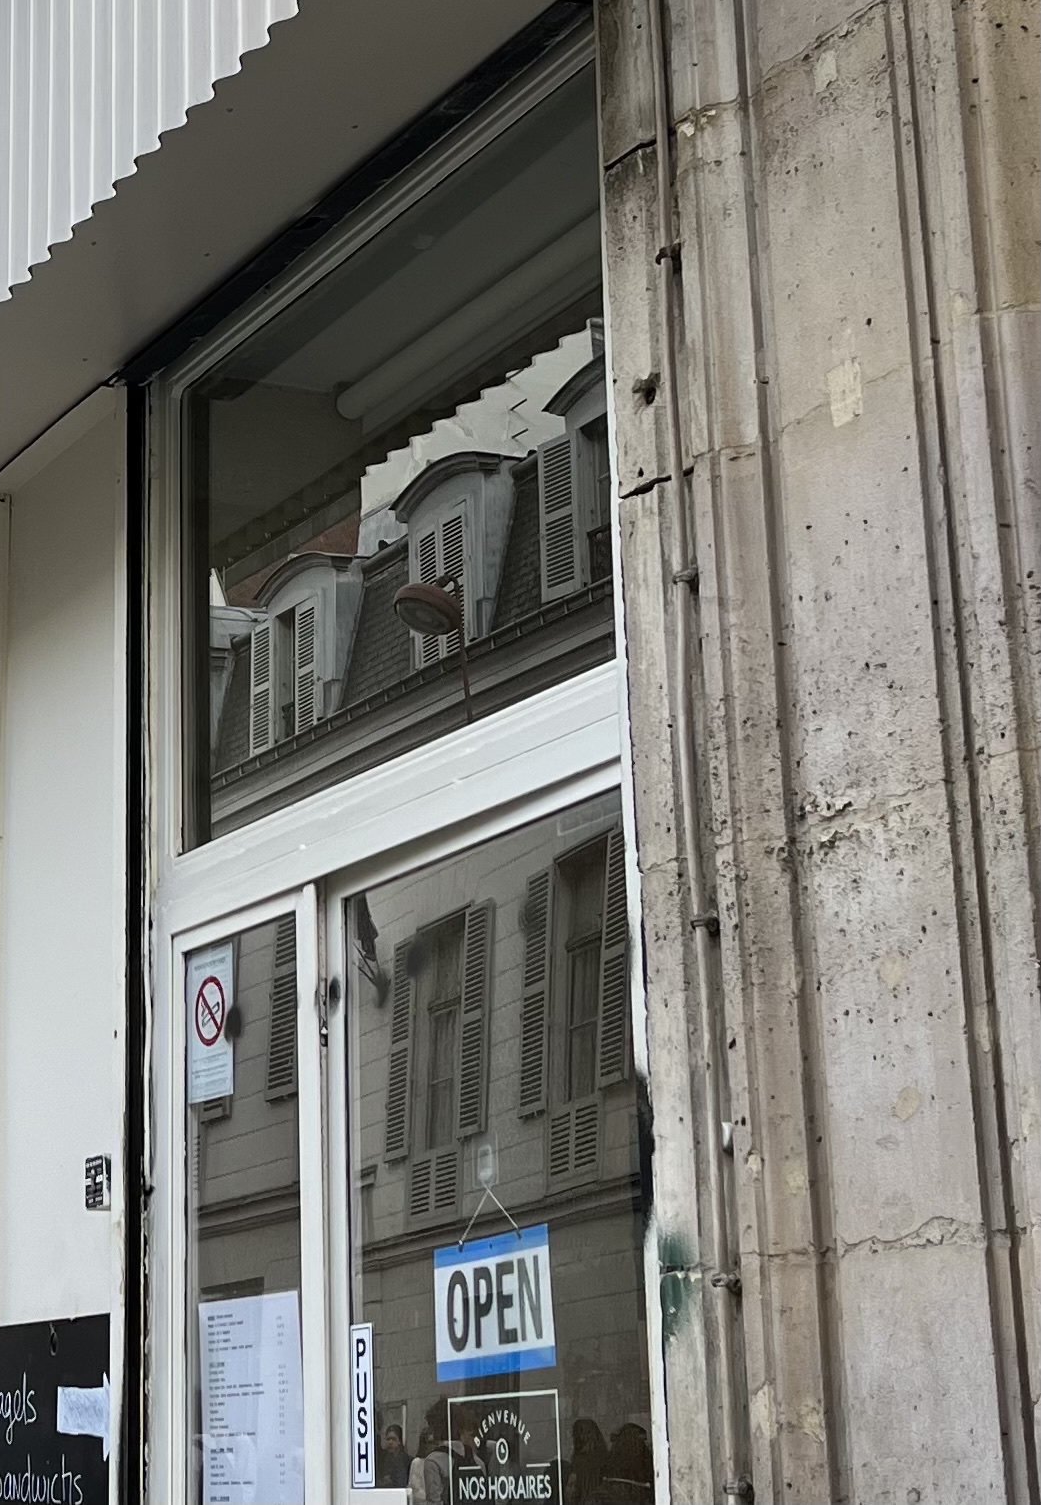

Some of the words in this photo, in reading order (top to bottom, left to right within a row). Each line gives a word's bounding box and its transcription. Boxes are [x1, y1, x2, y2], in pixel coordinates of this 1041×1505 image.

[447, 1254, 543, 1352] OPEN
[355, 1337, 369, 1474] PUSH
[473, 1409, 531, 1448] BIENVENUE
[459, 1476, 487, 1501] NOS
[488, 1474, 552, 1500] HORAIRES
